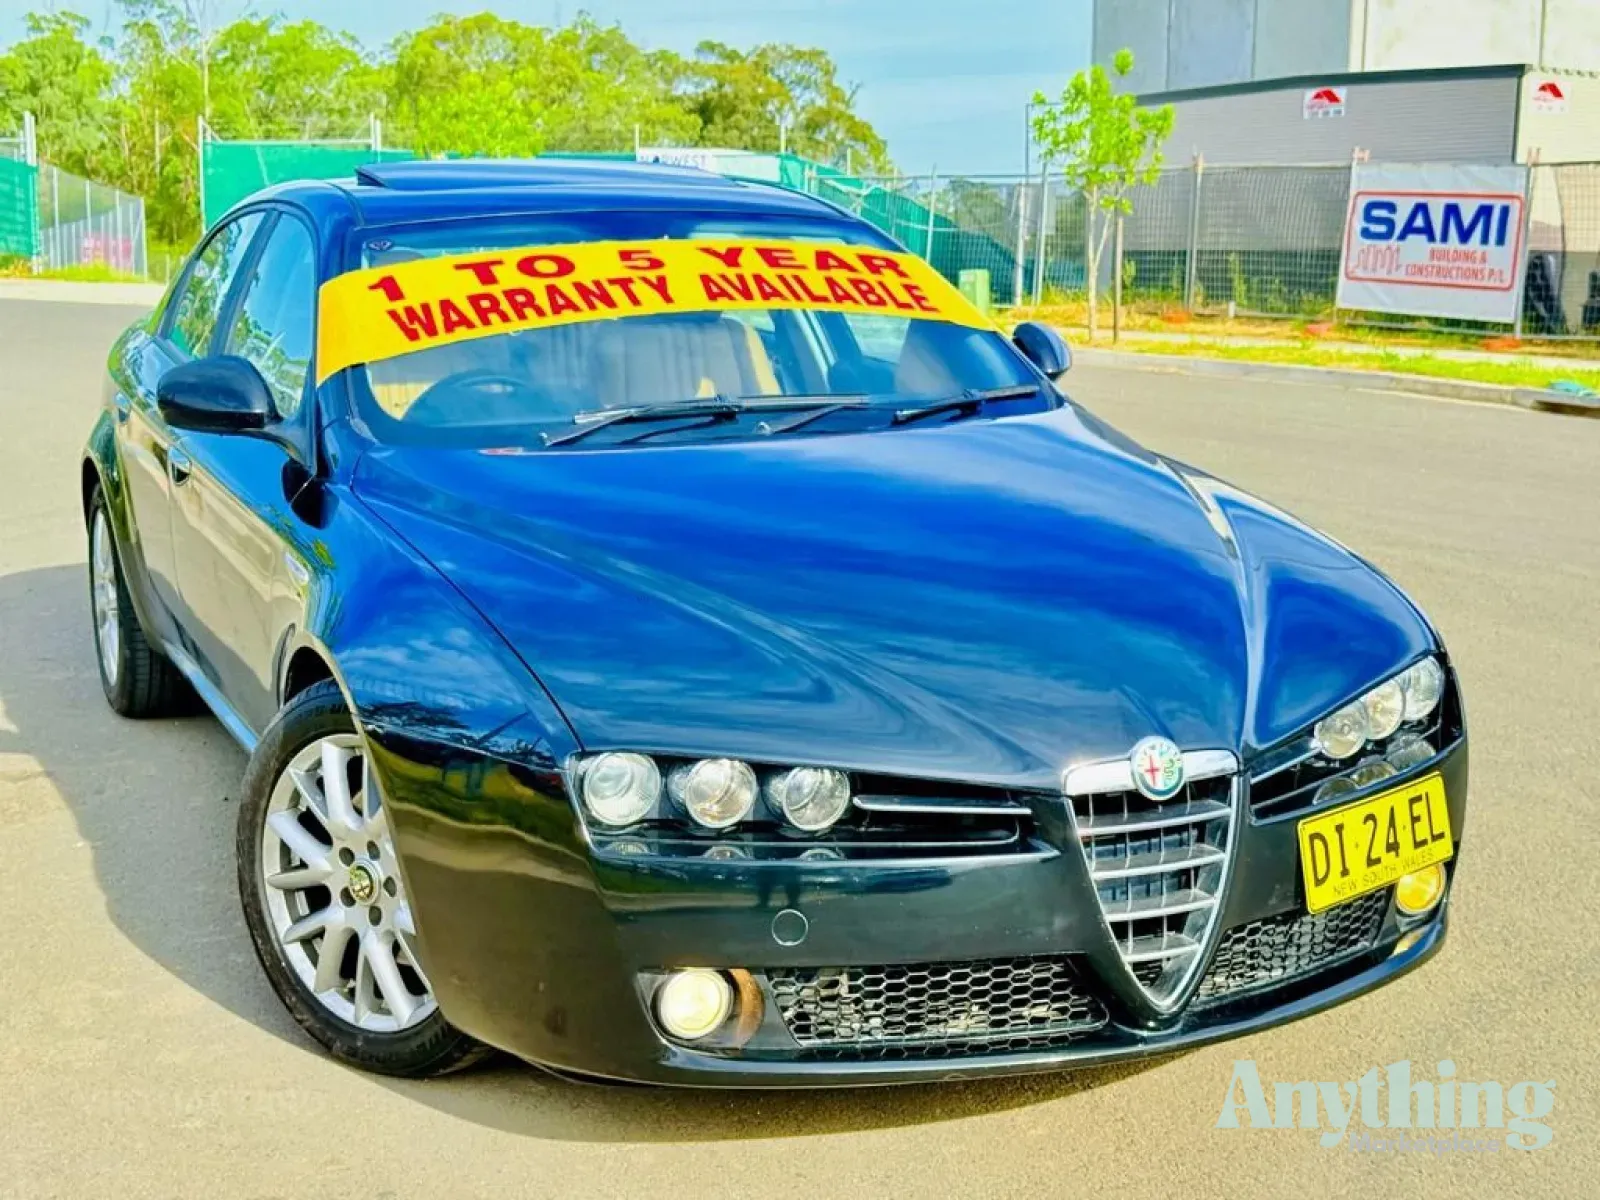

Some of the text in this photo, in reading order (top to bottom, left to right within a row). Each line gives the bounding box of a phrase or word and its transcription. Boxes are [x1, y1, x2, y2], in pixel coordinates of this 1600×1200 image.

[1360, 200, 1510, 247] SAMI
[368, 246, 910, 302] 1 TO 5 YEAR
[1404, 263, 1486, 281] CONSTRUCTIONS
[1428, 247, 1477, 264] BUILDING
[386, 273, 941, 342] WARRANTY AVAILABLE
[1308, 791, 1446, 887] DI 24 EL
[1333, 877, 1357, 896] NEW
[1362, 863, 1397, 887] SOUTH
